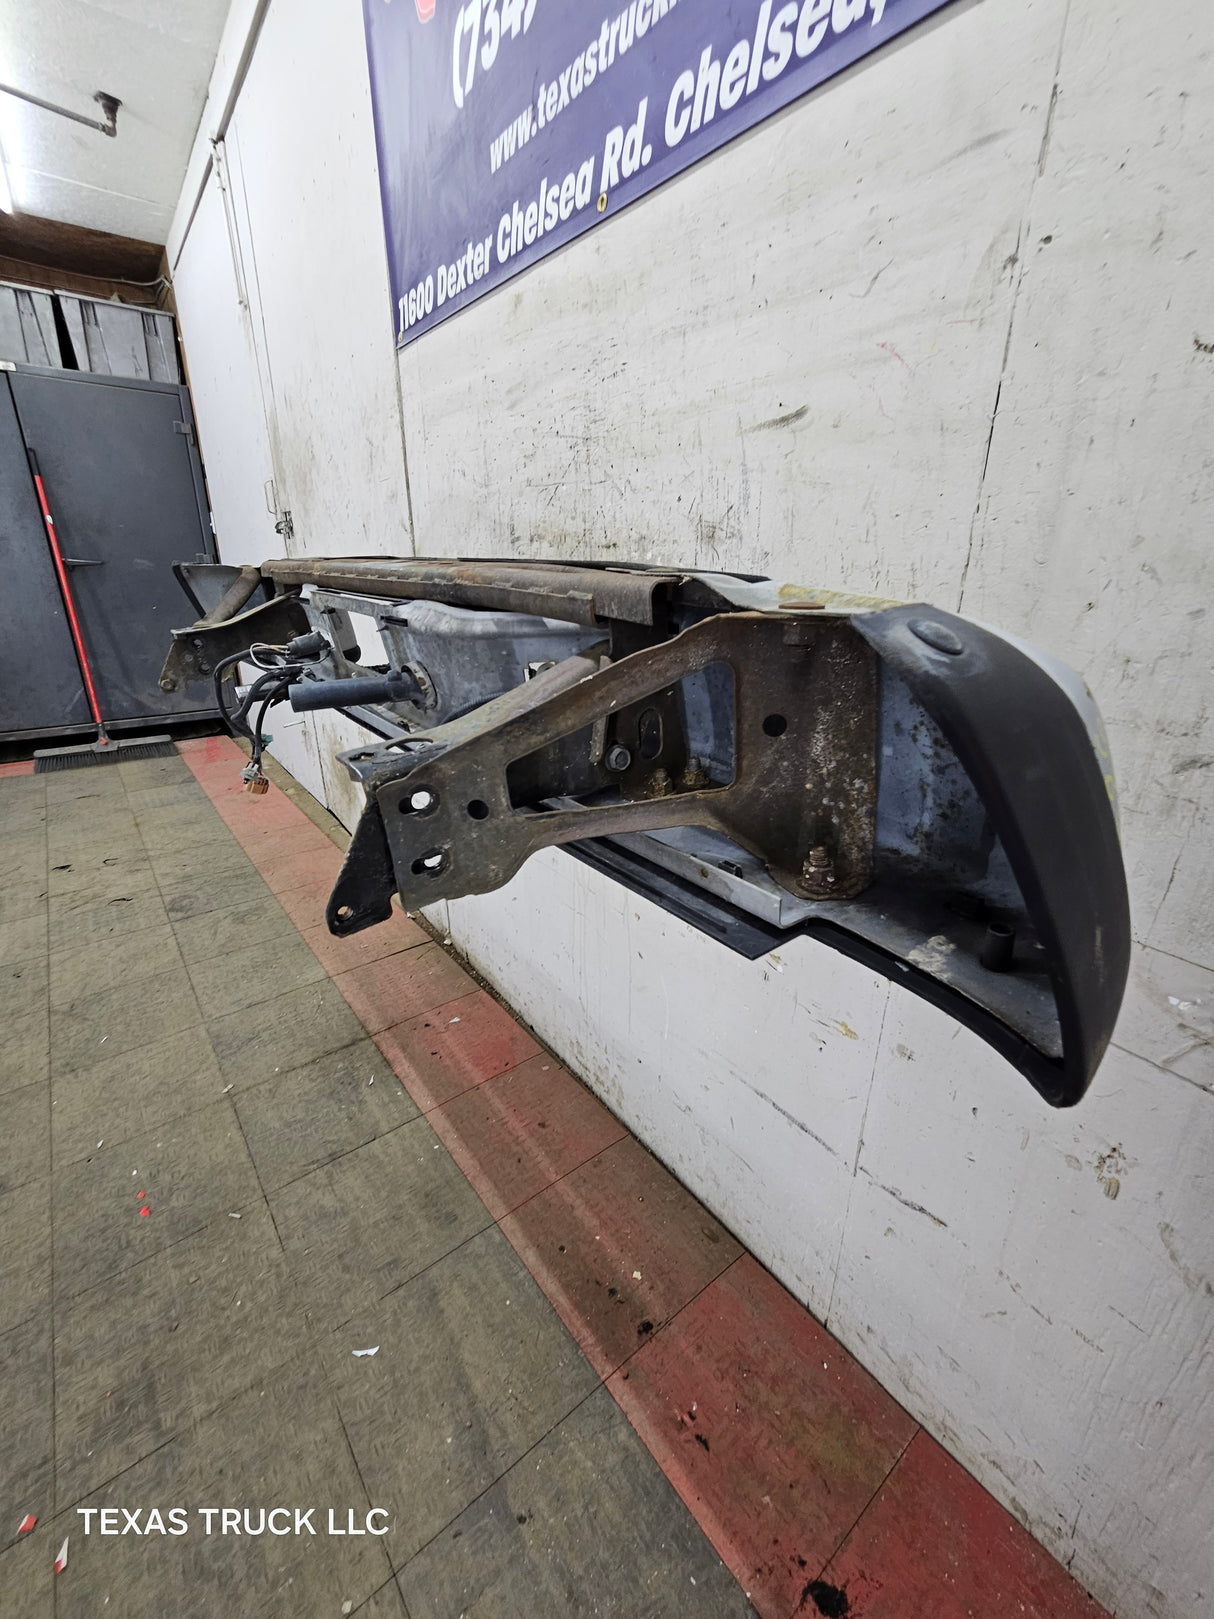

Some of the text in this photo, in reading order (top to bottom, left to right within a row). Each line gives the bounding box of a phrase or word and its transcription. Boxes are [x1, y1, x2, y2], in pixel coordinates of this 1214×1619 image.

[453, 0, 538, 109] (73
[399, 274, 434, 332] 11600
[437, 234, 493, 307] Dexter
[497, 156, 595, 263] Chelsea
[600, 96, 653, 193] Rd.
